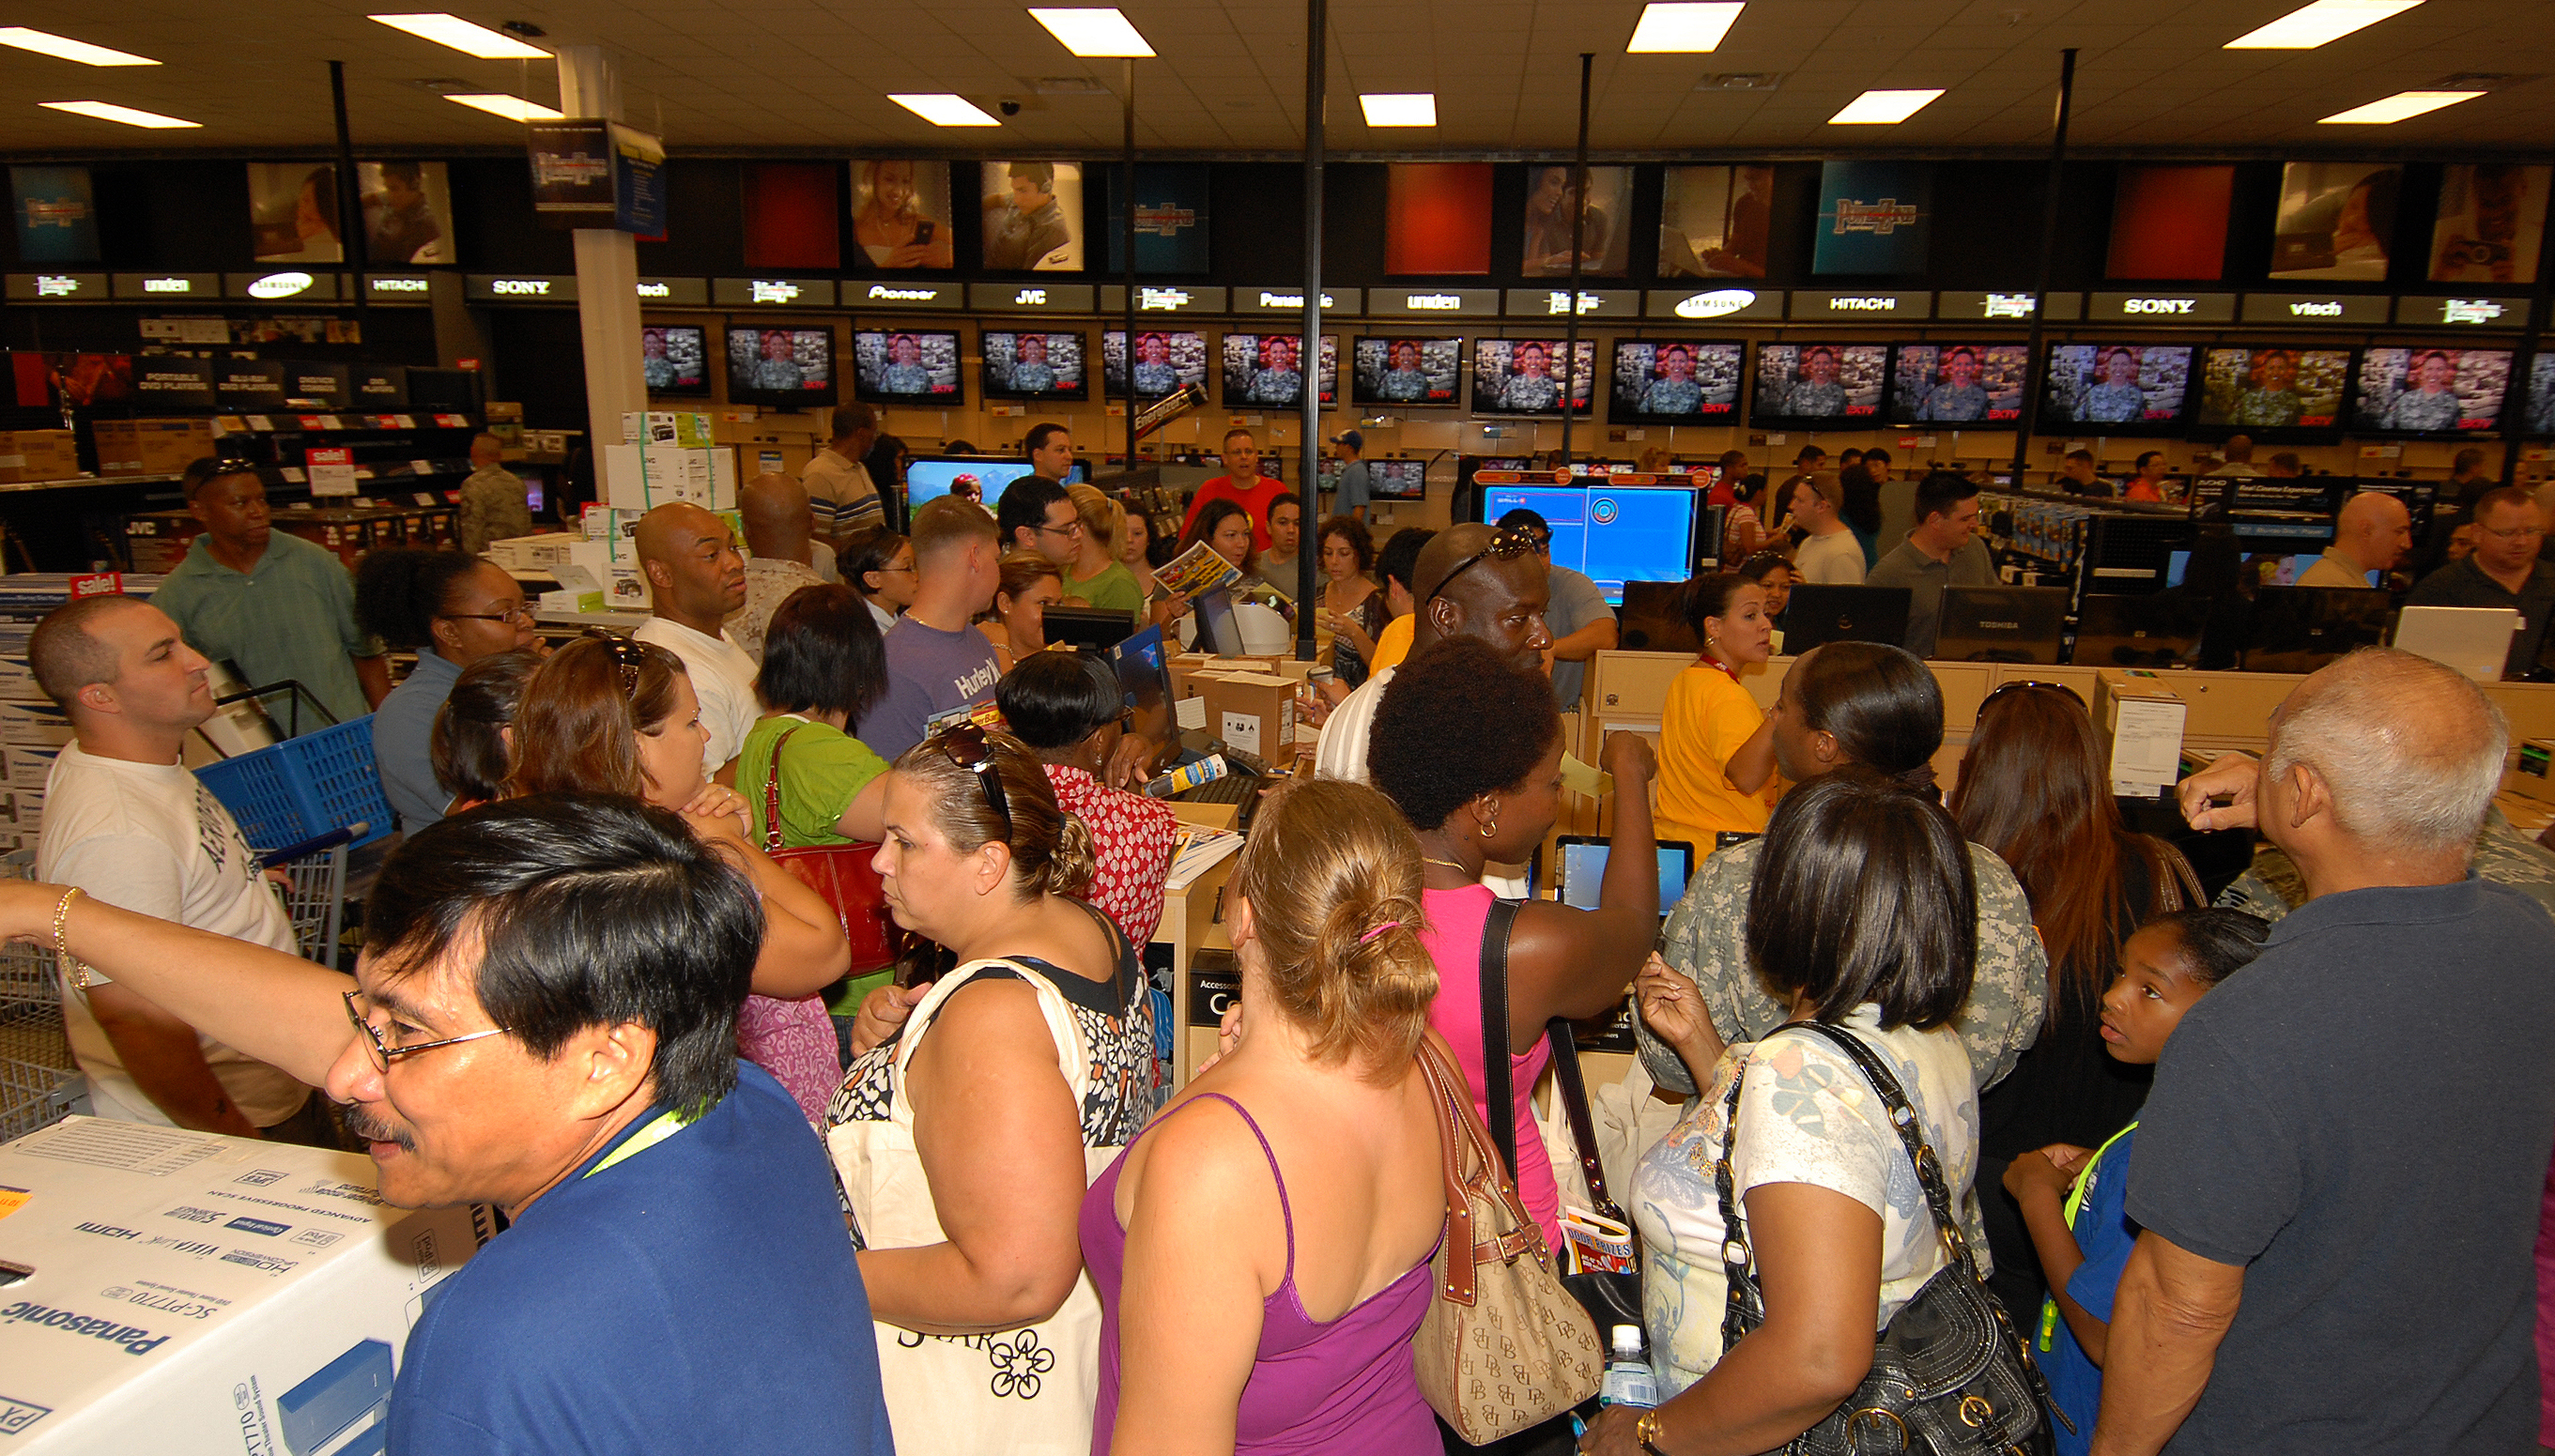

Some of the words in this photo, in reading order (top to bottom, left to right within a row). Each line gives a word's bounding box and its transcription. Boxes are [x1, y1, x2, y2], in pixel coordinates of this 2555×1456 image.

[144, 278, 191, 293] uniden
[373, 280, 428, 292] HITACHI
[493, 280, 550, 295] SONY
[636, 283, 670, 298] tech
[869, 284, 937, 300] Pioneer
[1015, 289, 1047, 304] JVC
[1259, 292, 1334, 308] Panasic
[1407, 293, 1461, 310] uniden
[1687, 299, 1745, 309] SAMSUNG
[1830, 298, 1897, 311] HITACHI
[2123, 299, 2196, 314] SONY
[2288, 301, 2344, 316] vtech
[146, 373, 200, 381] PORTABLE
[139, 381, 162, 391] DVD
[162, 381, 208, 391] PLAYERS
[239, 382, 280, 391] PLAYERS
[1135, 397, 1181, 431] Energizer
[312, 449, 346, 462] sale!
[125, 521, 157, 535] JVC
[77, 574, 117, 595] sale!
[1978, 621, 2020, 629] TOSHIBA
[954, 666, 993, 699] Hurley
[207, 1190, 237, 1201] SCAN
[237, 1196, 310, 1212] PROGRESSIVE
[310, 1208, 373, 1224] ADVANCED
[73, 1221, 142, 1240] HDMI
[1567, 1229, 1593, 1247] DOOR
[422, 1235, 435, 1262] iPod
[257, 1261, 291, 1275] HD
[128, 1292, 218, 1320] SC-PT770
[1, 1301, 172, 1356] Panasonic
